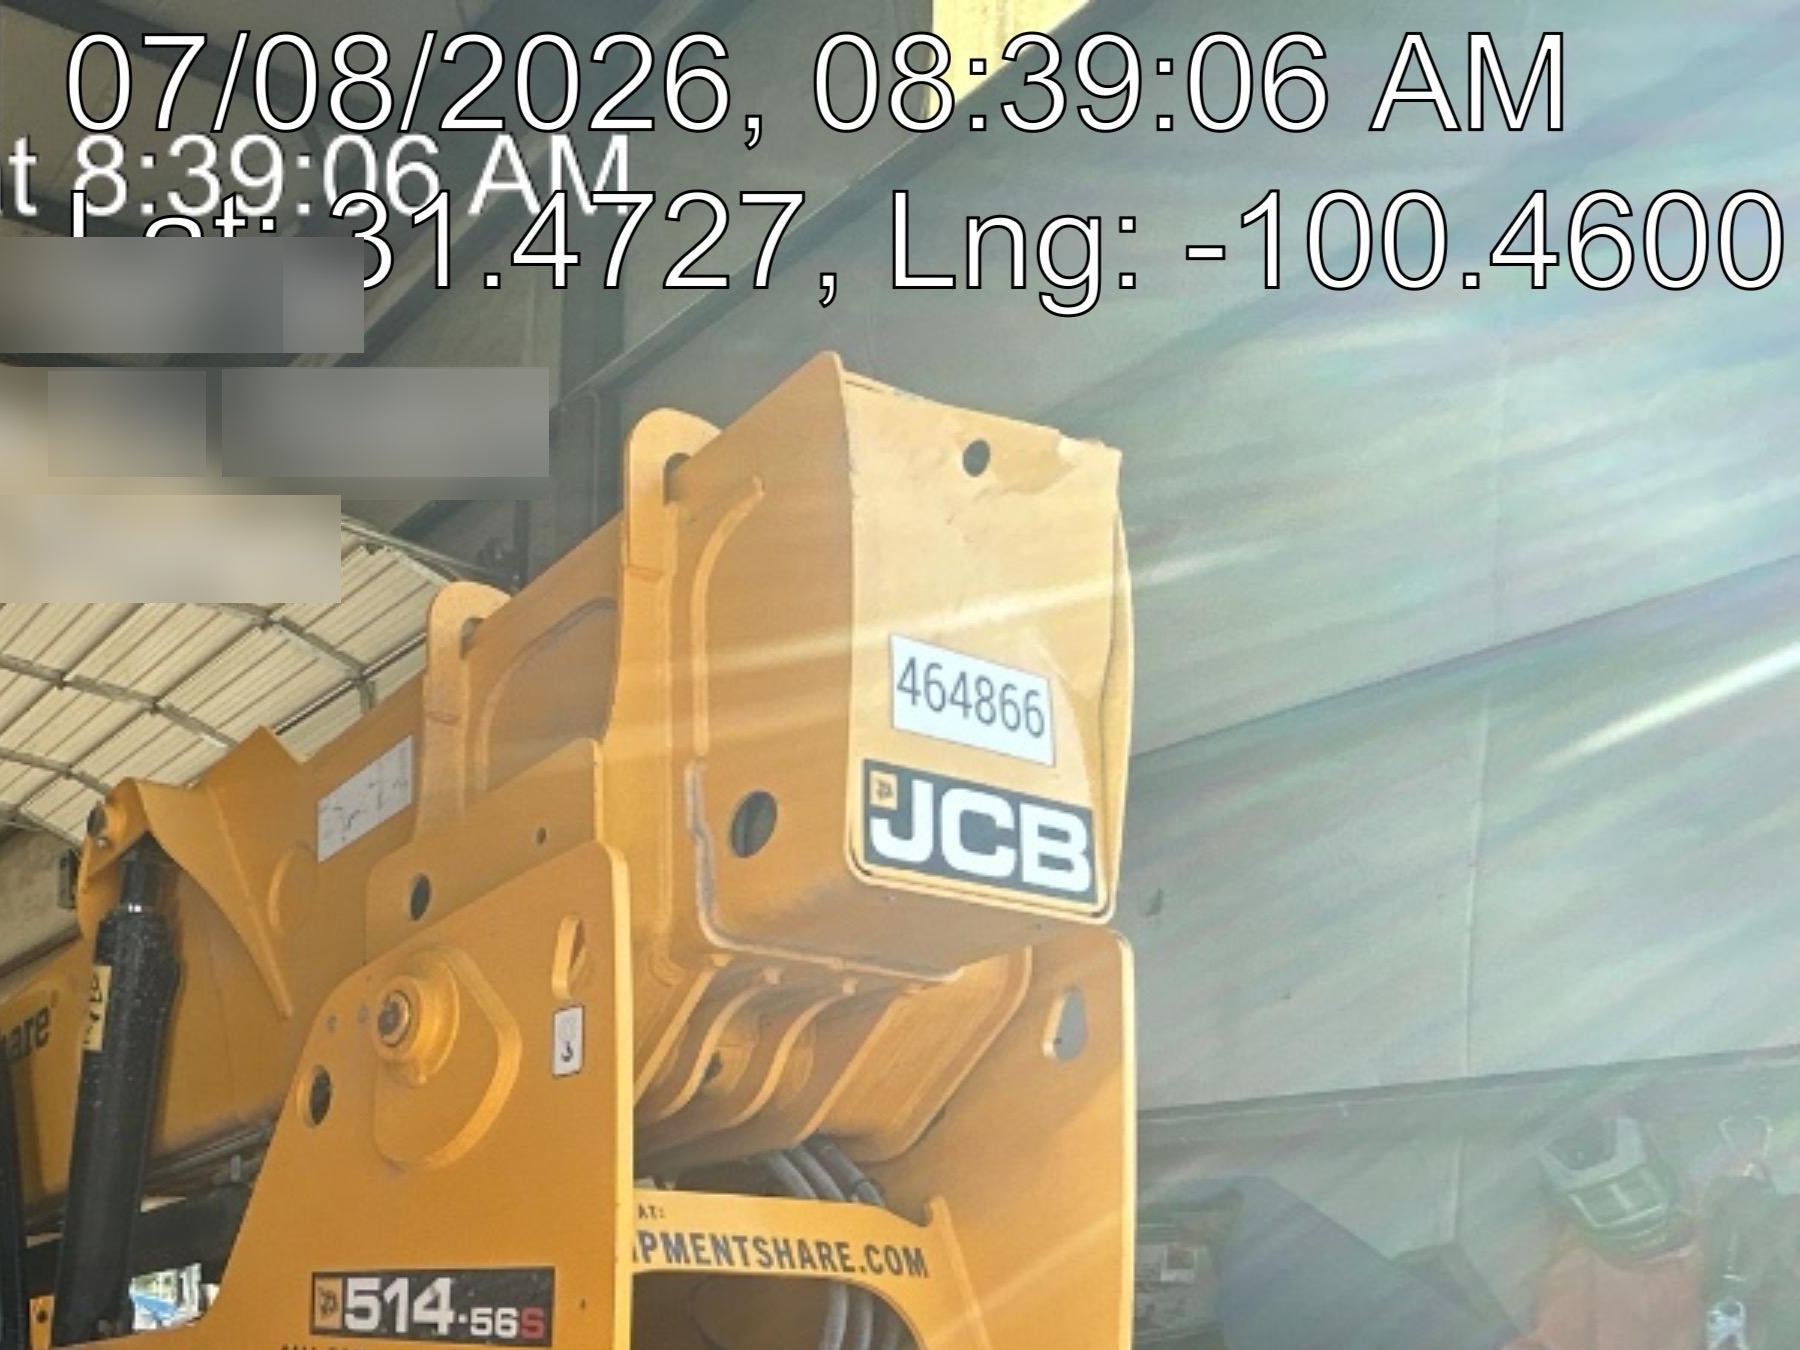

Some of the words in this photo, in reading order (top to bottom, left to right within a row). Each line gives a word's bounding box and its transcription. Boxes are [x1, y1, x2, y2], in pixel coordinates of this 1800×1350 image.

[896, 656, 1046, 740] 464866
[868, 778, 1092, 893] JCB
[633, 1230, 929, 1278] PMENTSHARE.COM
